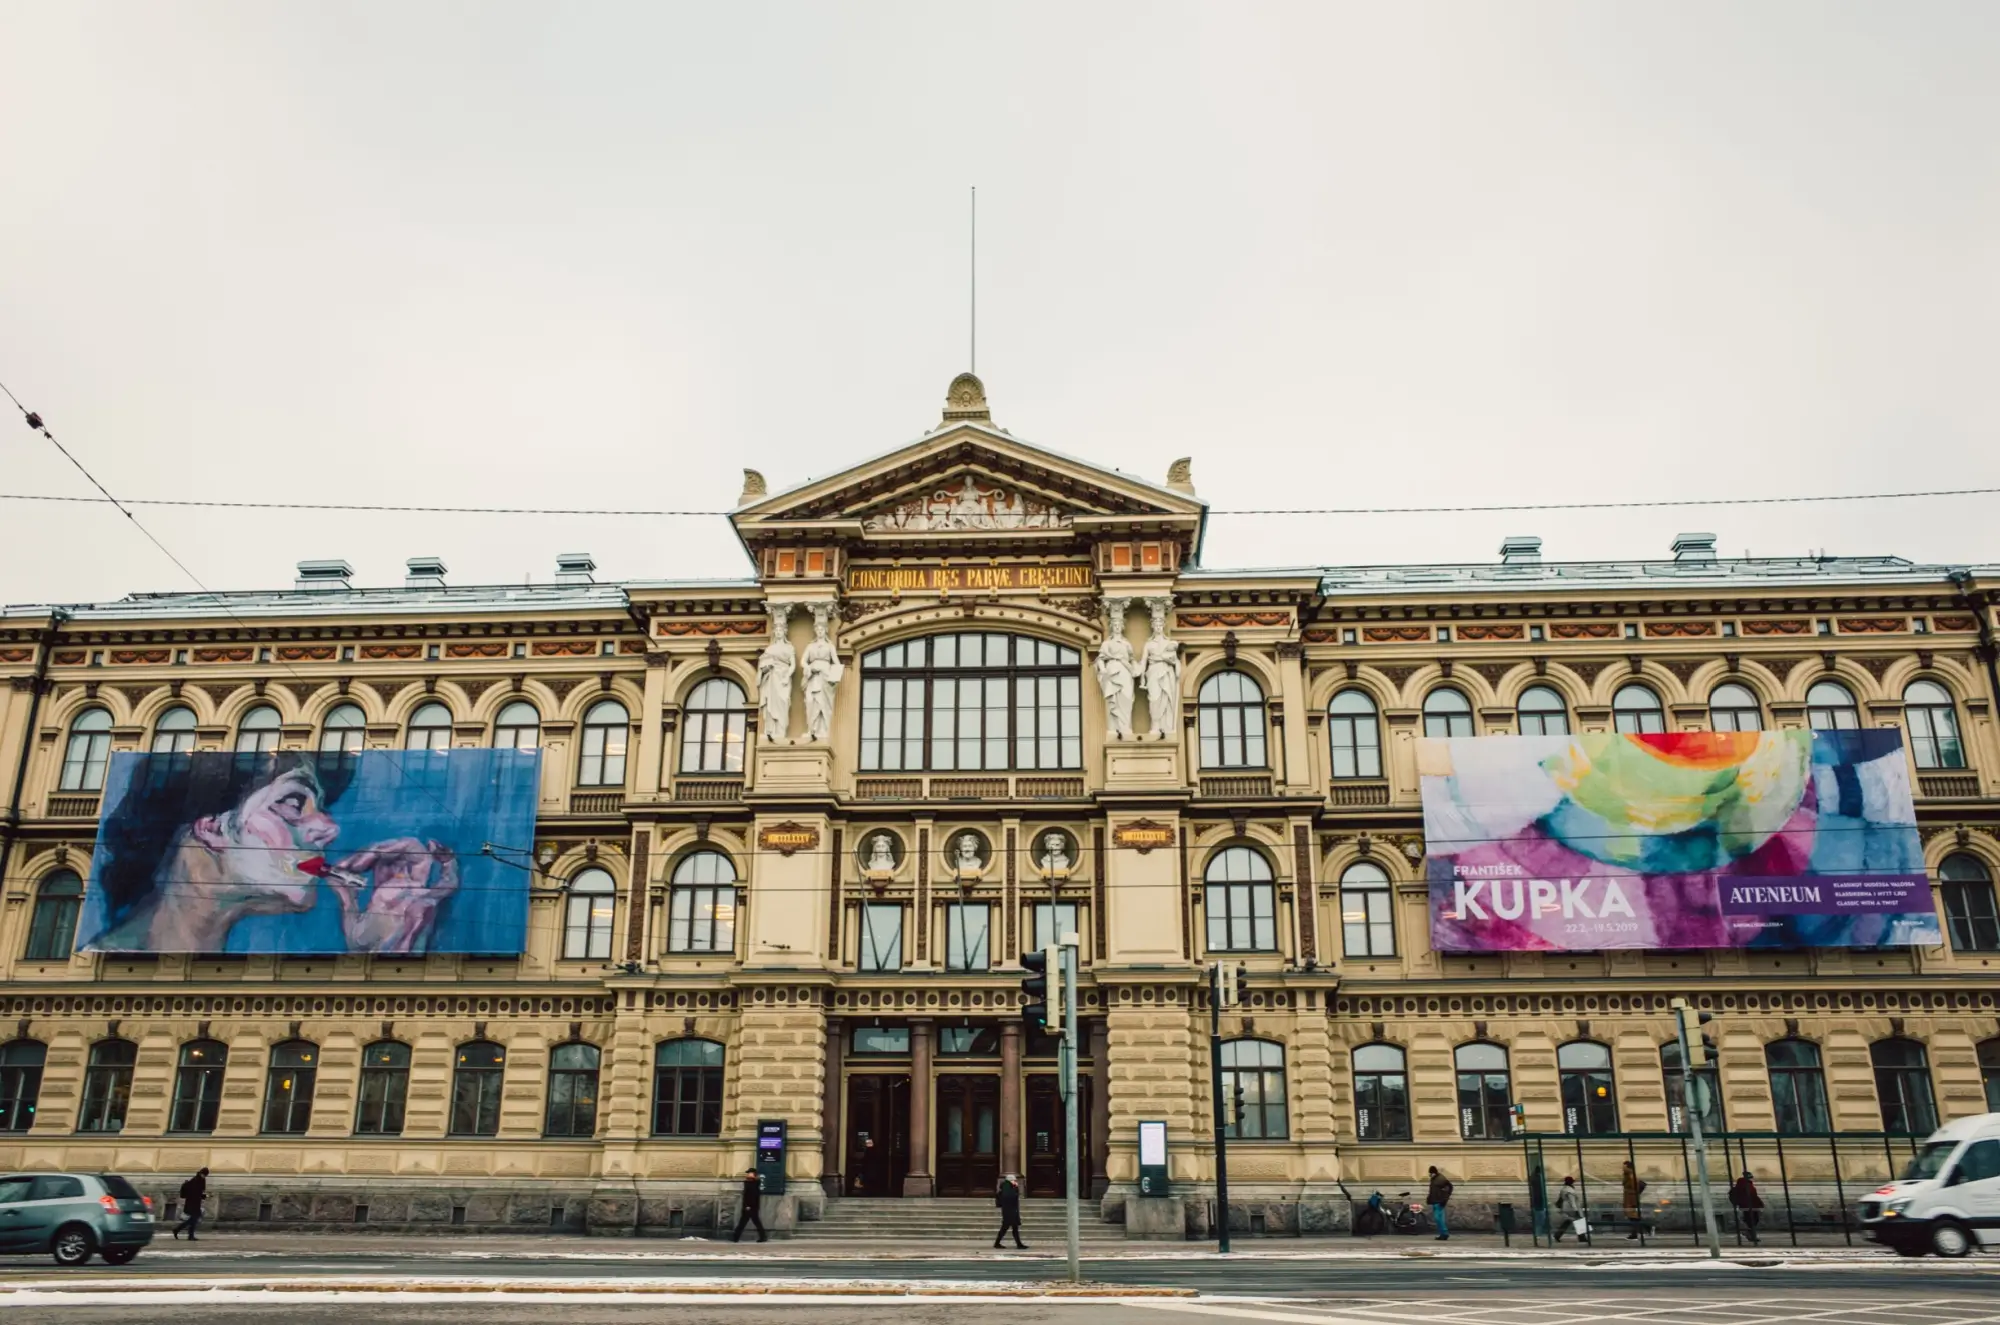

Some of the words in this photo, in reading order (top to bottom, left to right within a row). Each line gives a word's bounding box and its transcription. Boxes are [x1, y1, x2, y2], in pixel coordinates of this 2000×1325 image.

[851, 569, 926, 588] CONCORDIA
[933, 569, 959, 587] RES
[1020, 567, 1090, 585] CRESCUNT
[1453, 862, 1522, 876] FRANTIŠEK
[1454, 878, 1636, 920] KUPKA
[1730, 886, 1821, 903] ATENEUM
